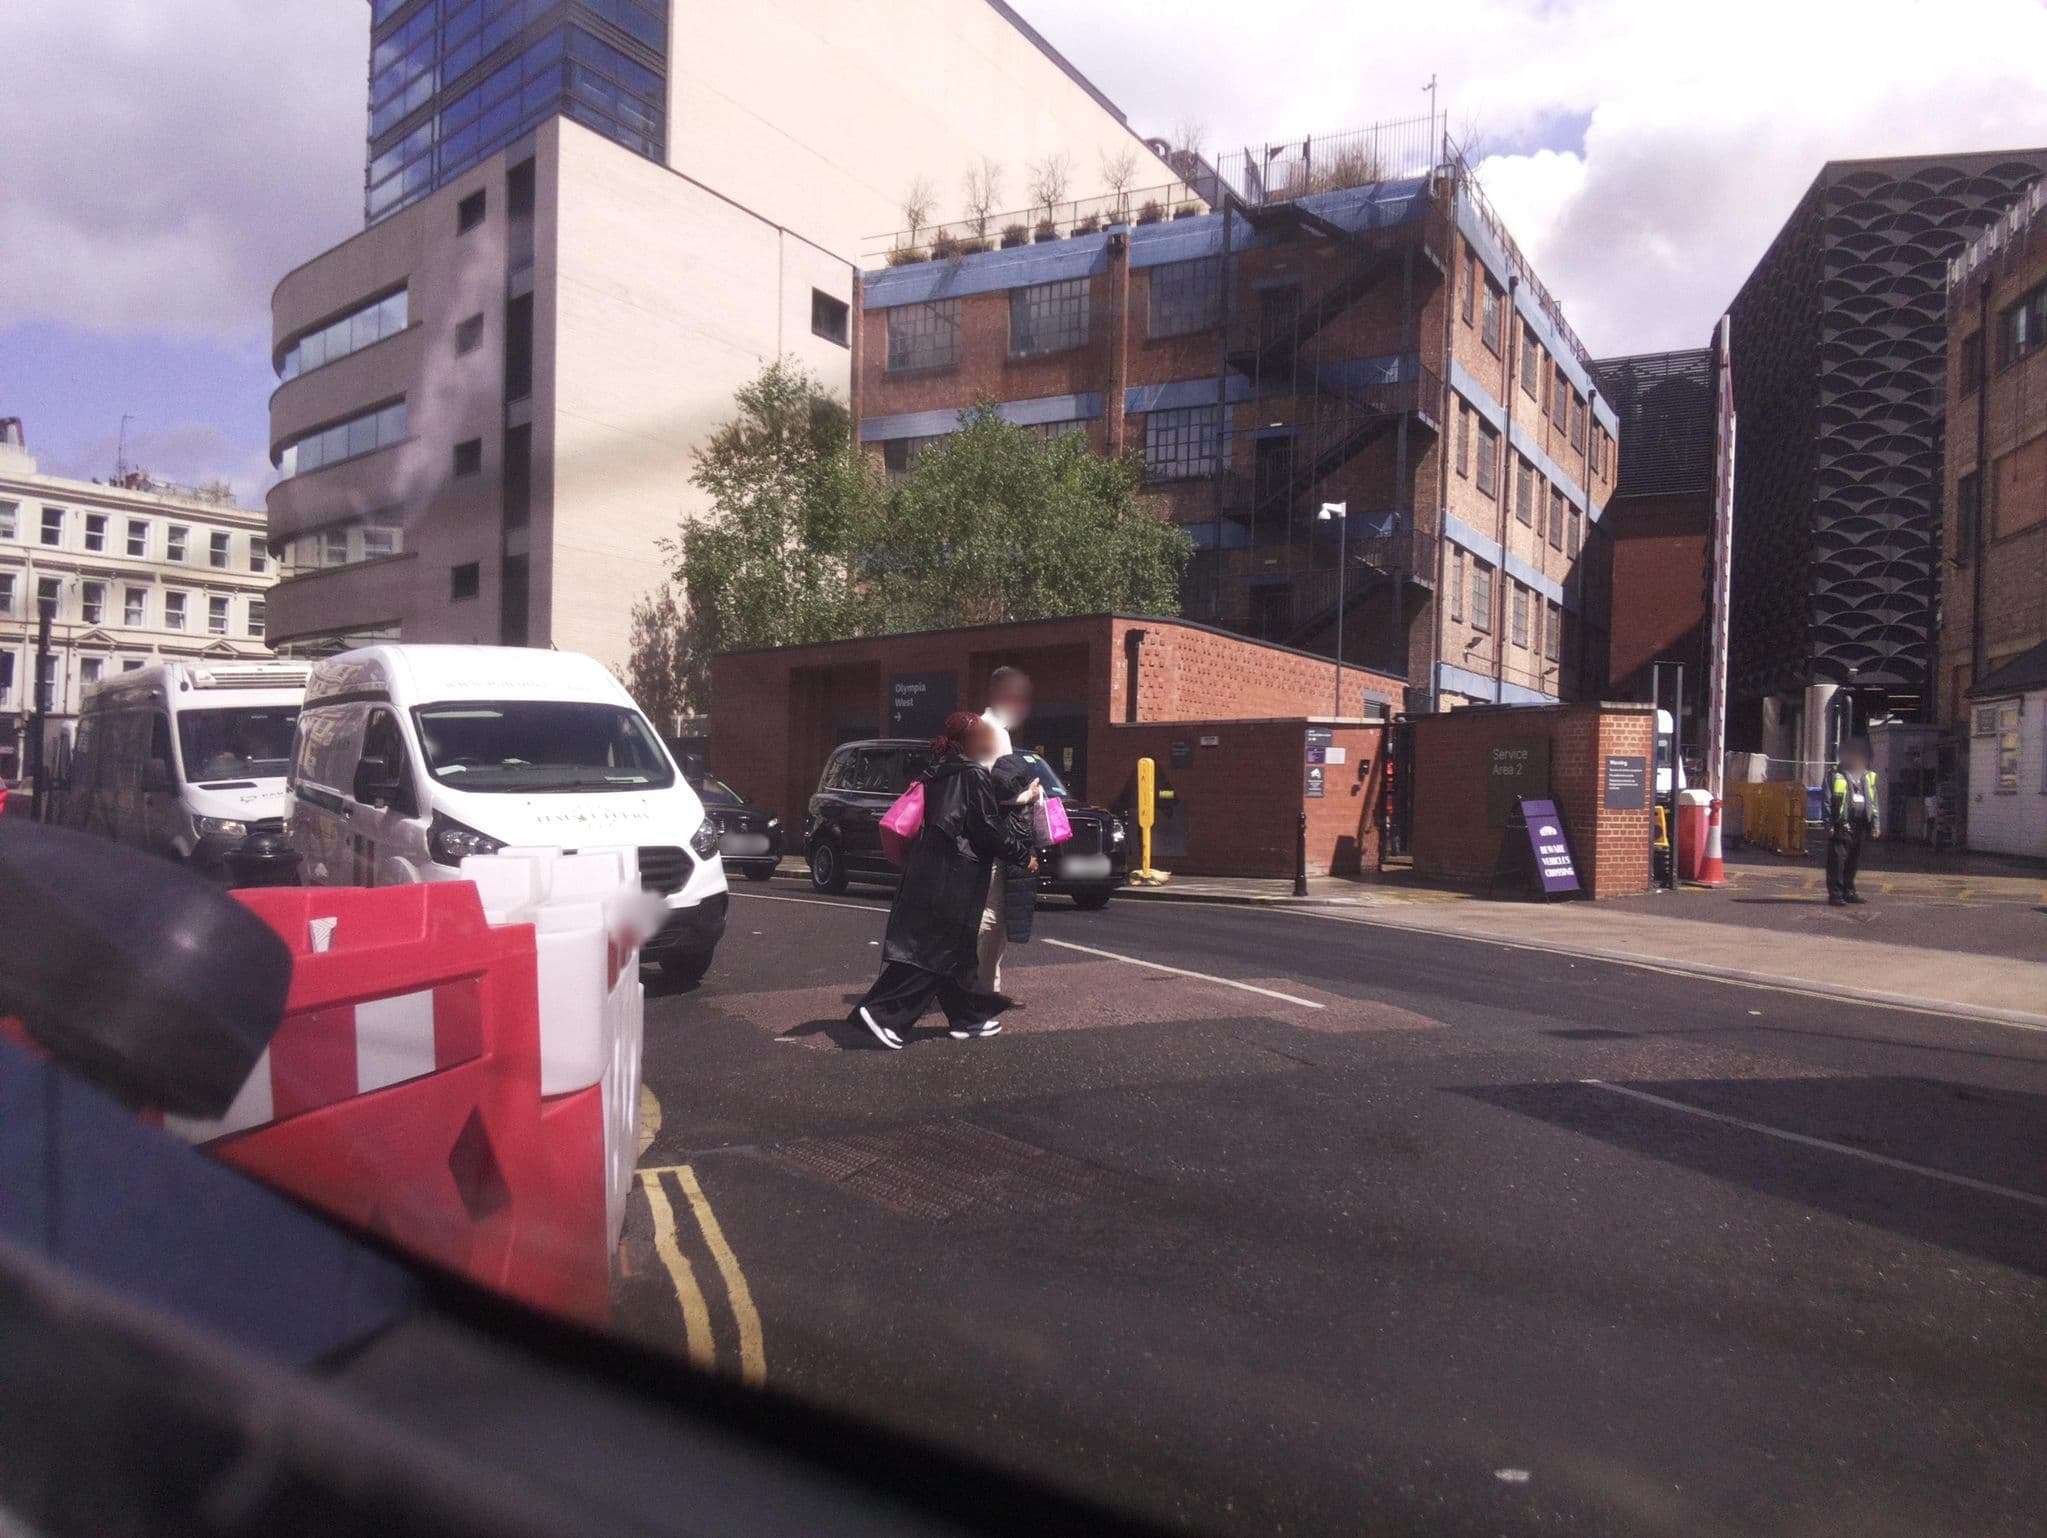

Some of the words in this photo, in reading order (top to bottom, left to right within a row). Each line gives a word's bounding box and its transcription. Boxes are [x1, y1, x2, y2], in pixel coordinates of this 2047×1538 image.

[895, 682, 925, 694] Olympia
[895, 698, 913, 707] West
[1492, 748, 1529, 761] Service
[1492, 764, 1514, 776] Area
[1515, 762, 1524, 776] 2
